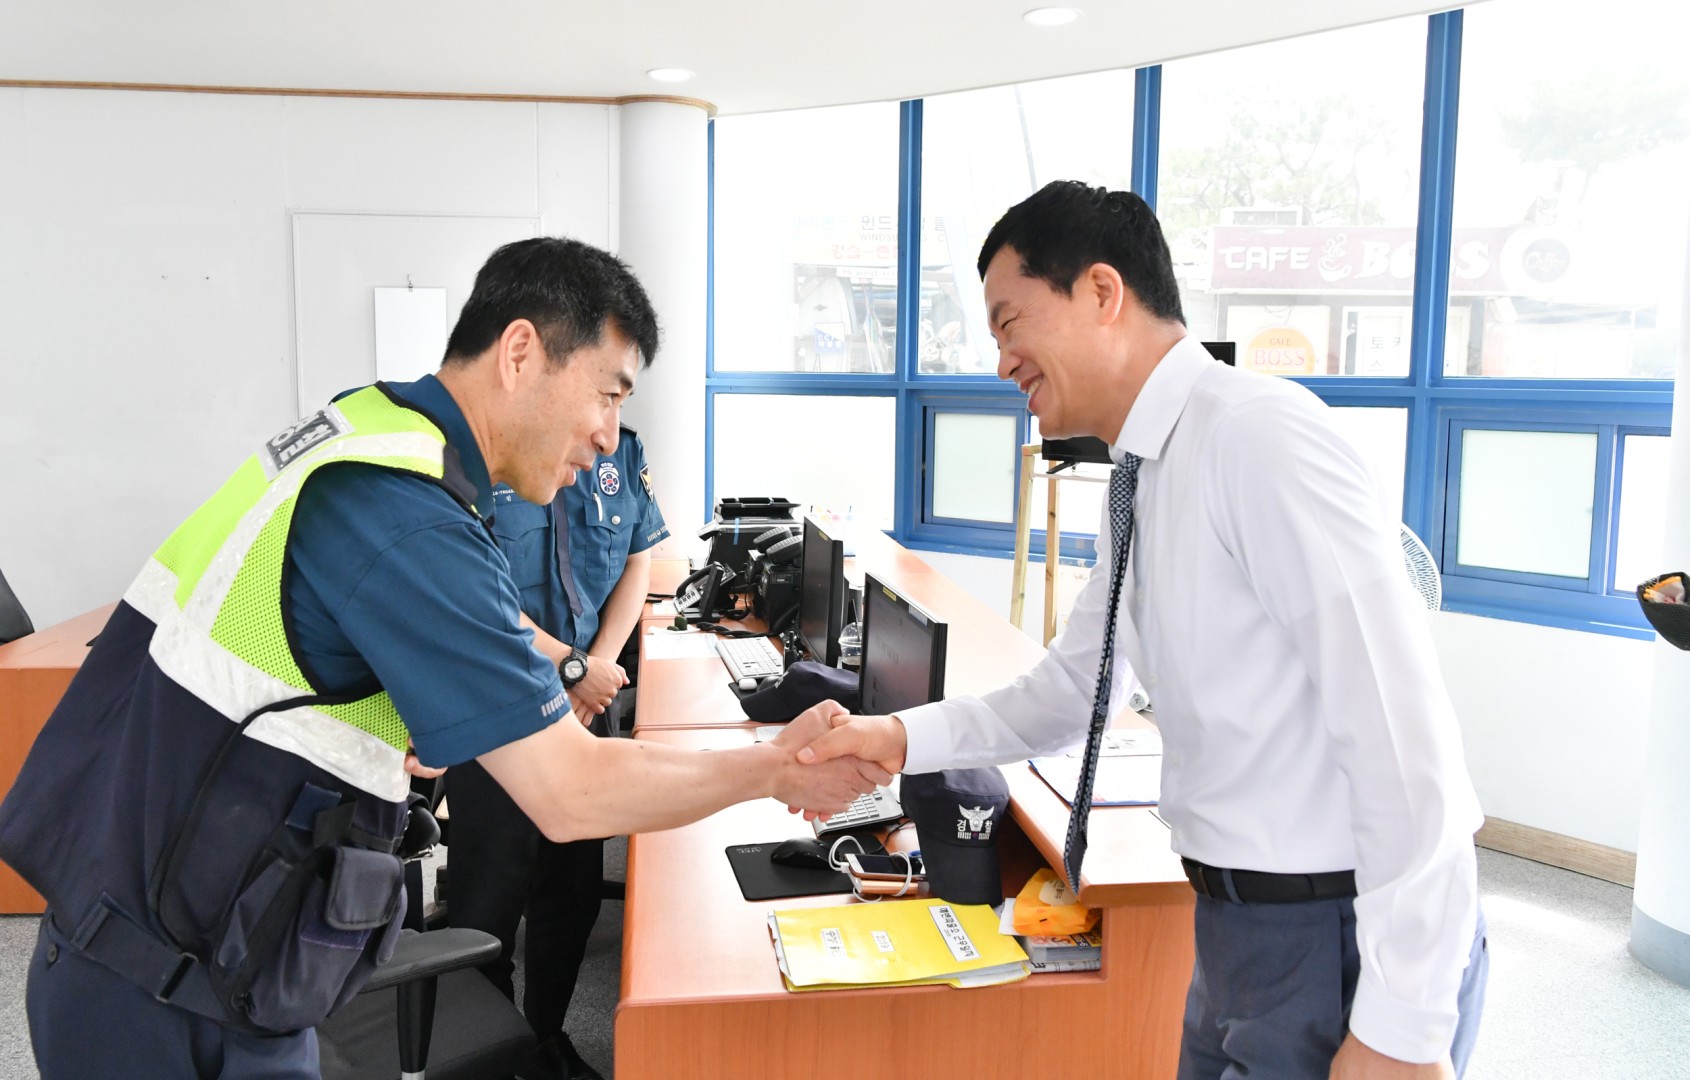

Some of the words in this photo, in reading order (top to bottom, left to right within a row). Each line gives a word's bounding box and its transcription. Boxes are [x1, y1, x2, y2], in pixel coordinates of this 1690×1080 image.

[1218, 246, 1312, 272] CAFE
[1354, 240, 1491, 281] BOS
[1269, 337, 1291, 346] CAFE
[1254, 349, 1305, 367] BOSS
